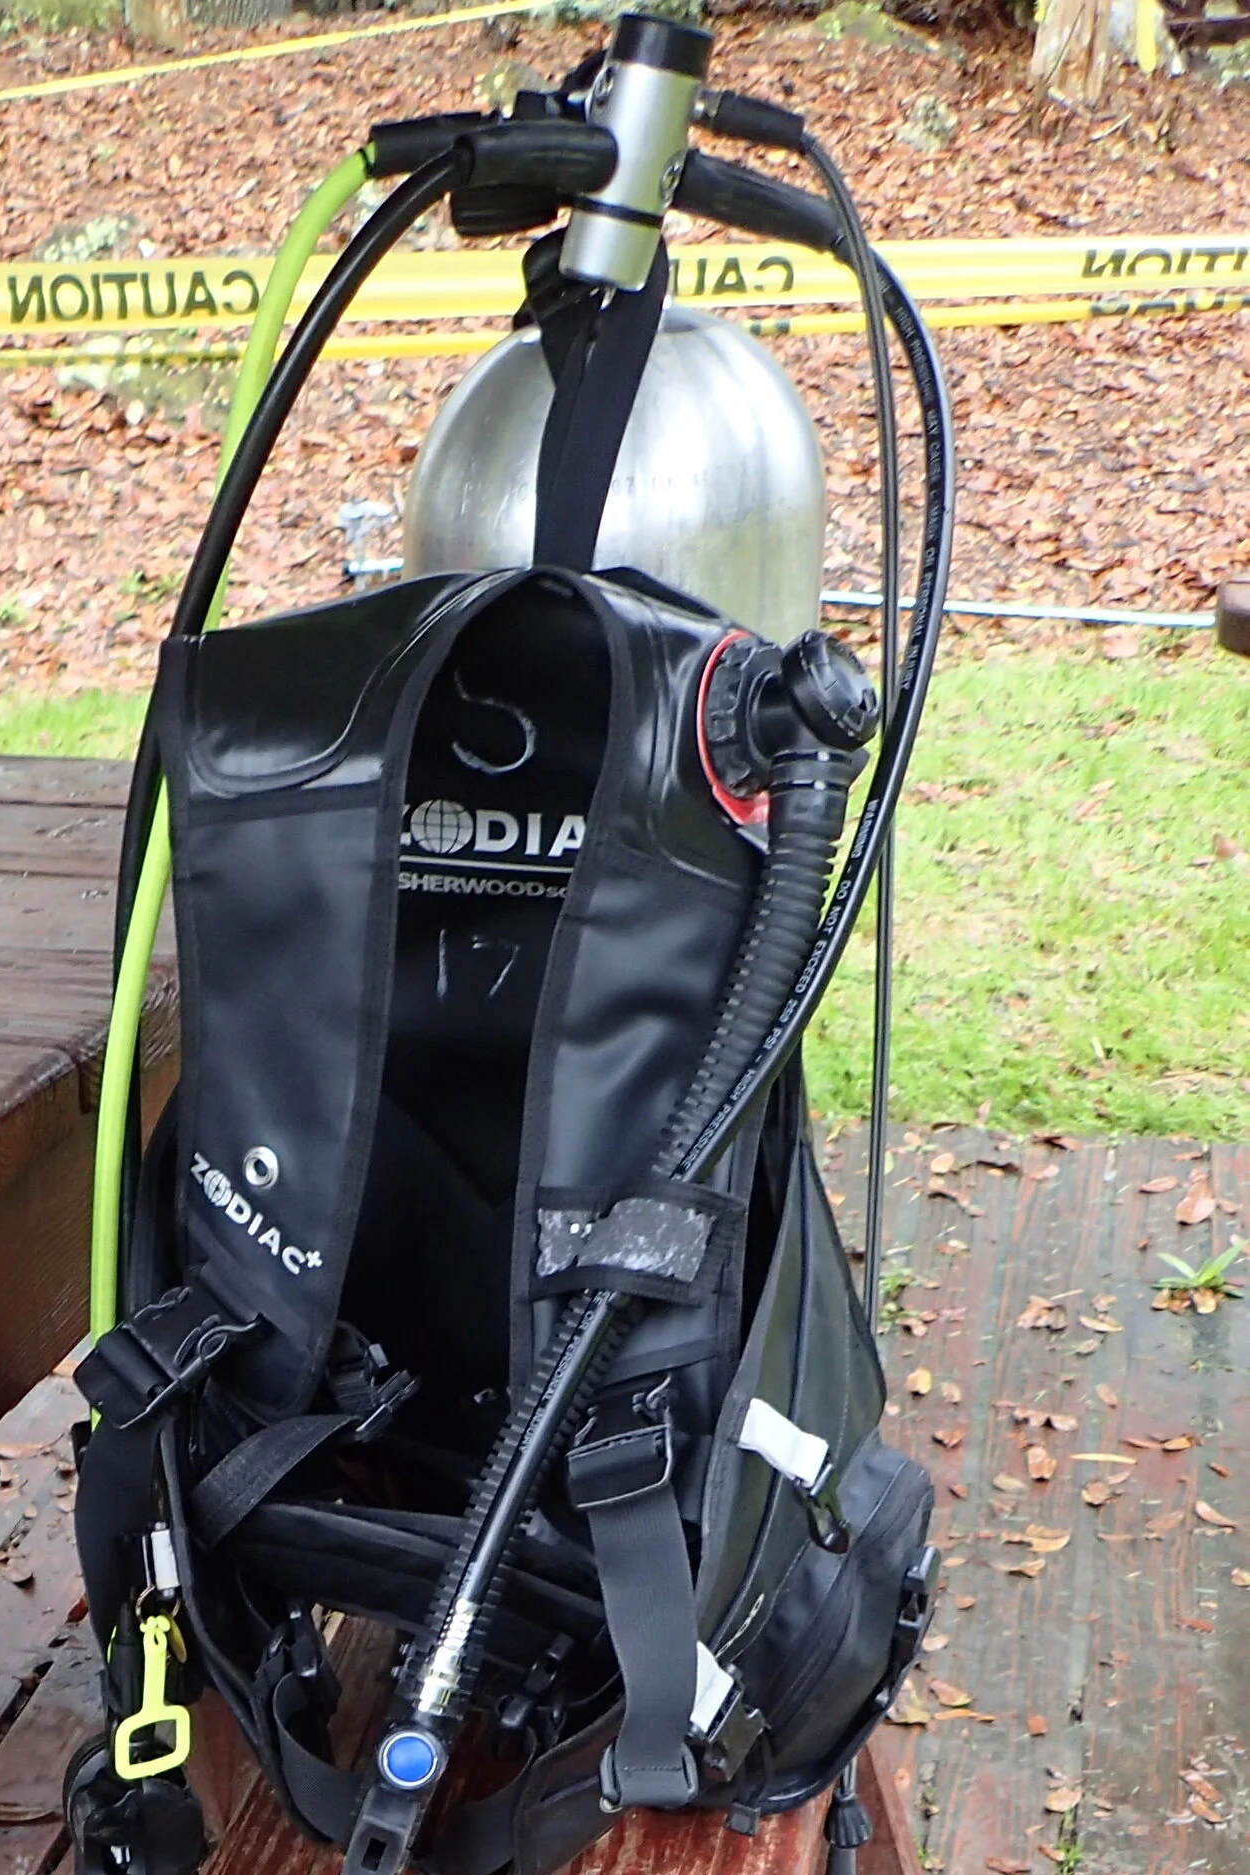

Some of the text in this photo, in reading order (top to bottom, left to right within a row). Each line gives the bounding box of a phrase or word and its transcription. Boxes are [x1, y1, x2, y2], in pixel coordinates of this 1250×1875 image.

[836, 880, 852, 899] DO
[825, 906, 842, 934] NOT
[795, 940, 827, 993] EXCEED
[763, 1027, 782, 1050] PSI
[682, 1103, 731, 1170] PRESSURE
[541, 1335, 581, 1401] PERSONAL
